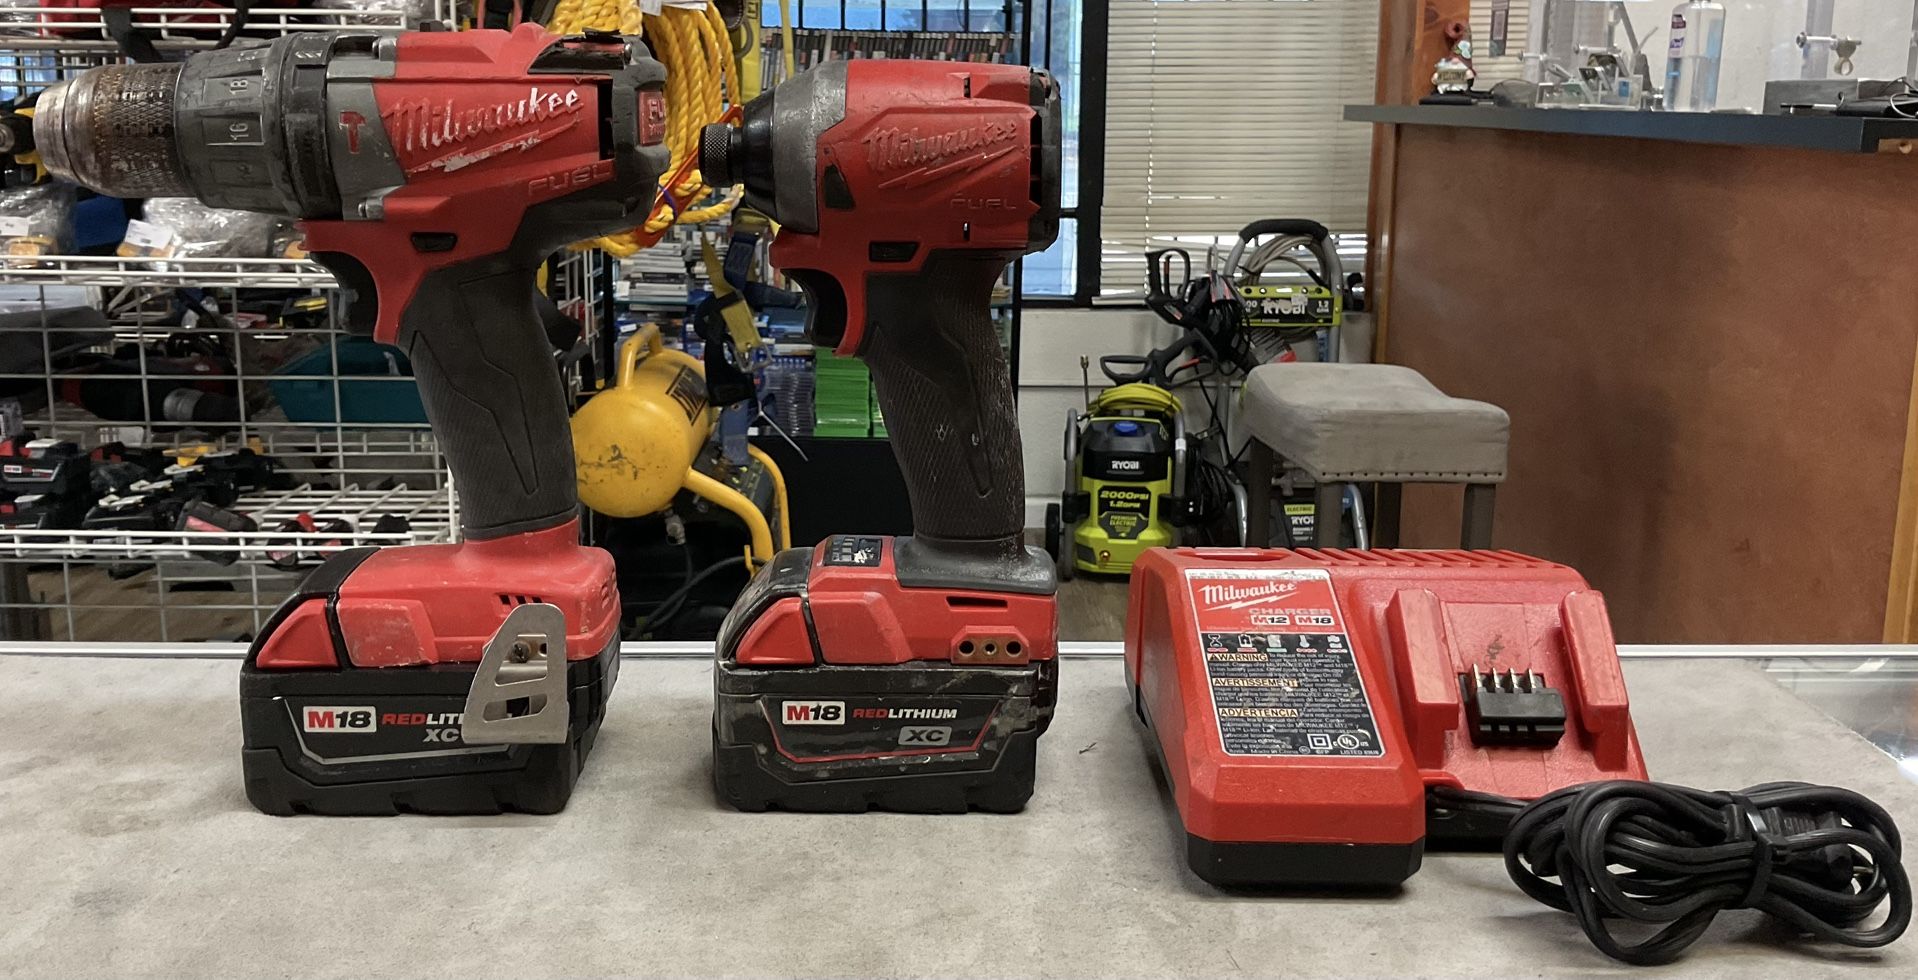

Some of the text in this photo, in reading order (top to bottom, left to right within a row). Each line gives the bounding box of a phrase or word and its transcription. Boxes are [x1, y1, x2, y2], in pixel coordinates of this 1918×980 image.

[382, 86, 584, 151] Milwaukee
[862, 115, 1017, 173] Milwaukee
[527, 163, 613, 197] FUEL
[950, 198, 1017, 210] FUEL
[1111, 460, 1139, 470] RYOBI
[1197, 580, 1297, 605] Milwaukee
[1253, 615, 1332, 625] M12 M18
[1218, 653, 1267, 661] WARNING
[1214, 678, 1297, 686] AVERTISSEMENT
[307, 710, 465, 729] M18 REDLIT
[786, 704, 957, 721] M18 REDLITHIUM
[1221, 708, 1297, 717] ADVERTENCIA
[422, 728, 460, 743] XC
[903, 729, 944, 743] XC
